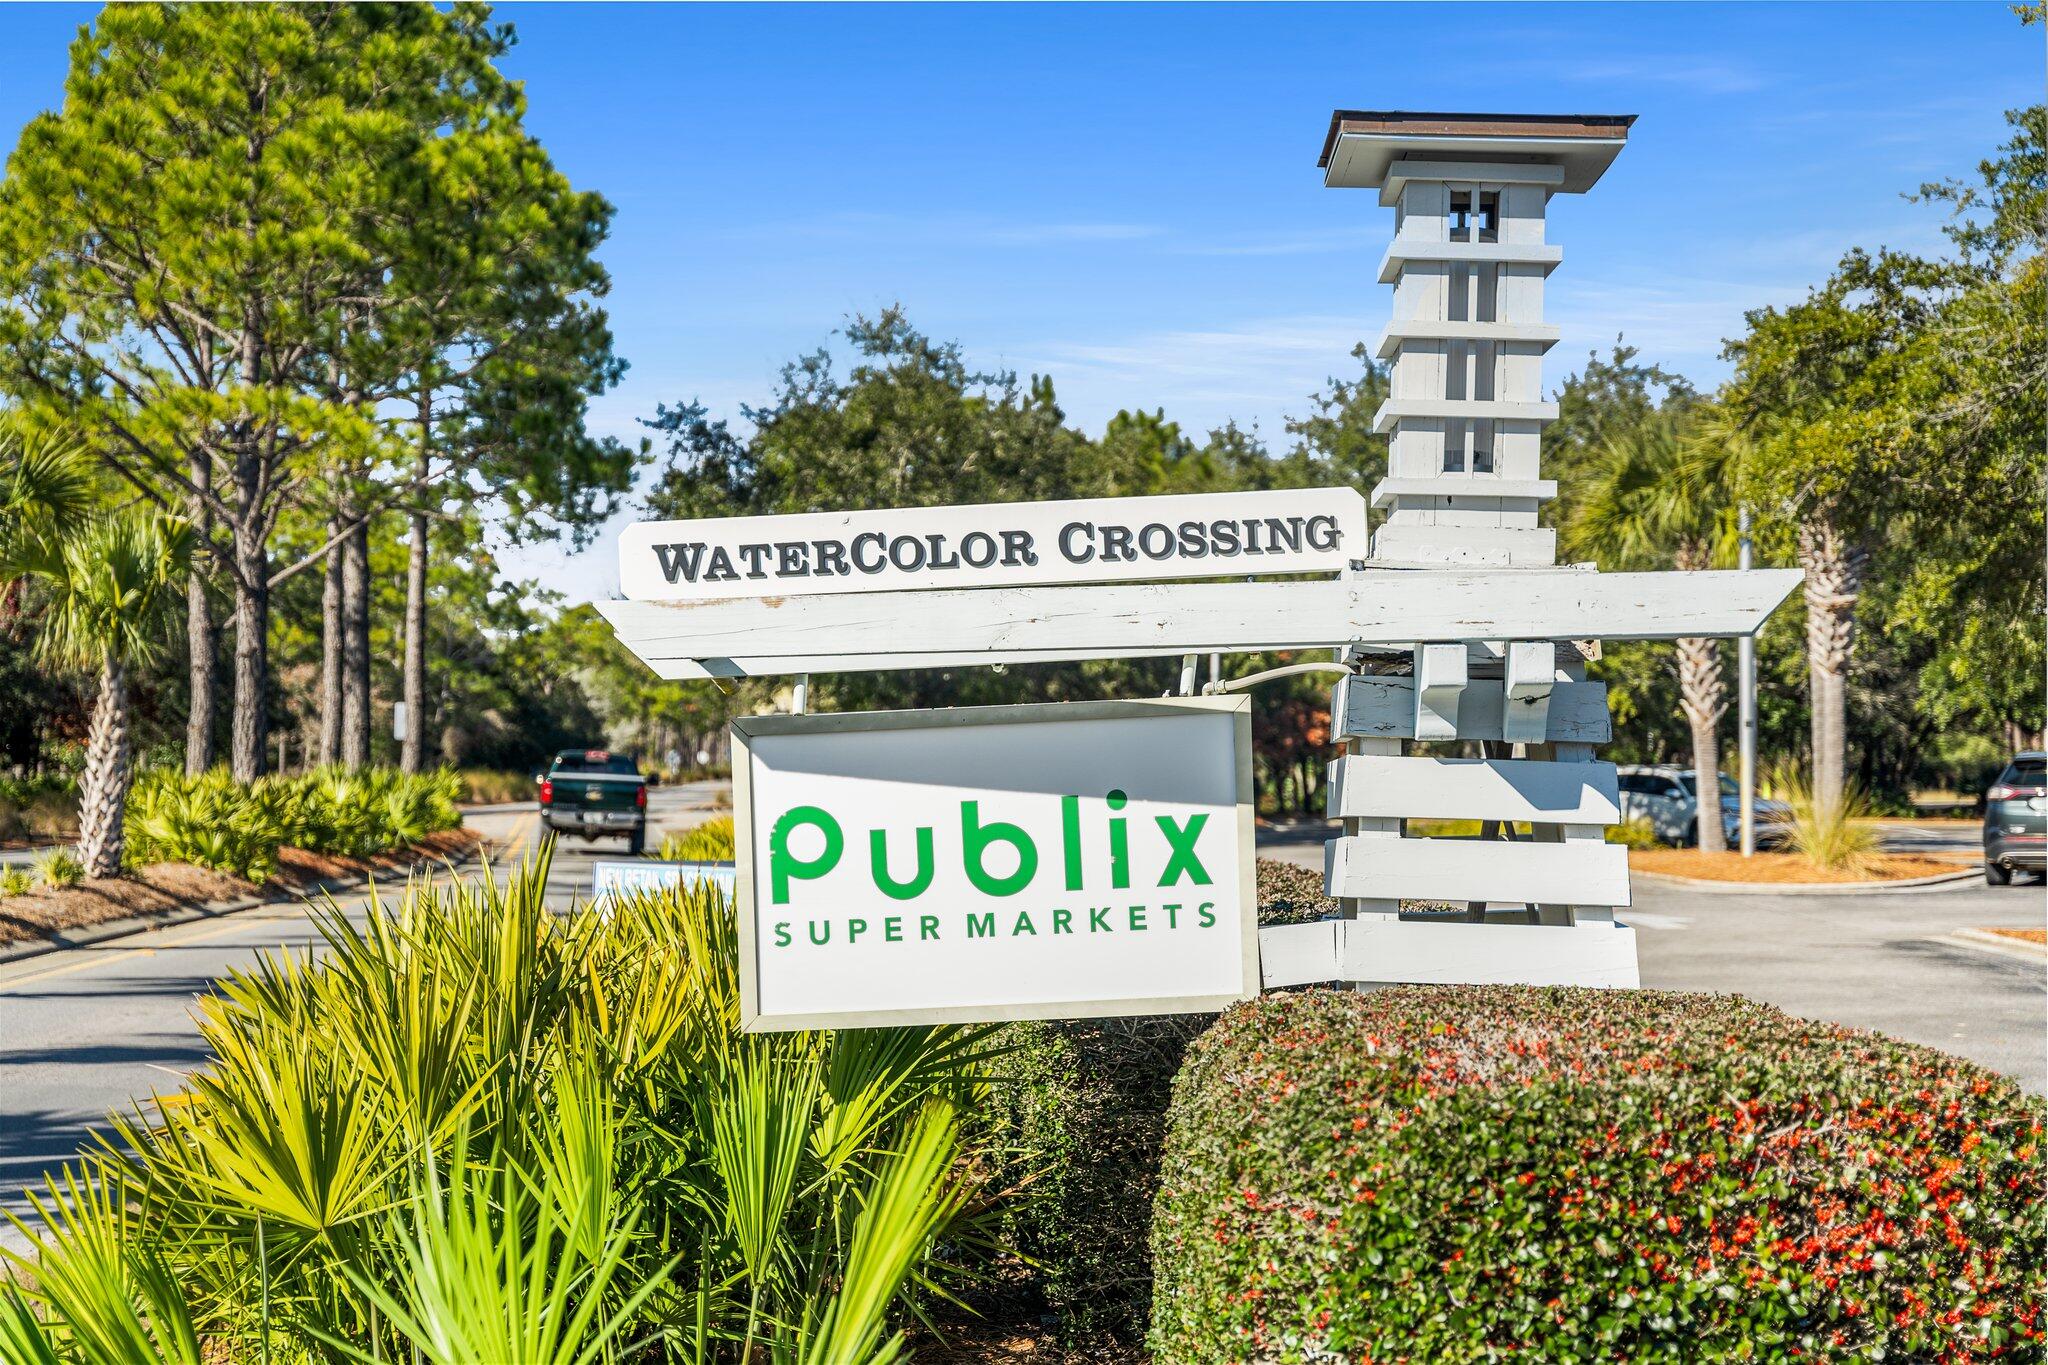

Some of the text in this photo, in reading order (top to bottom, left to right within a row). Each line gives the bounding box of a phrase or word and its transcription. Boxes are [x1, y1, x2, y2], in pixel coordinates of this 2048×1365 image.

[1057, 515, 1342, 564] CROSSING
[769, 789, 1214, 905] Publix
[774, 902, 1217, 947] SUPER MARKETS
